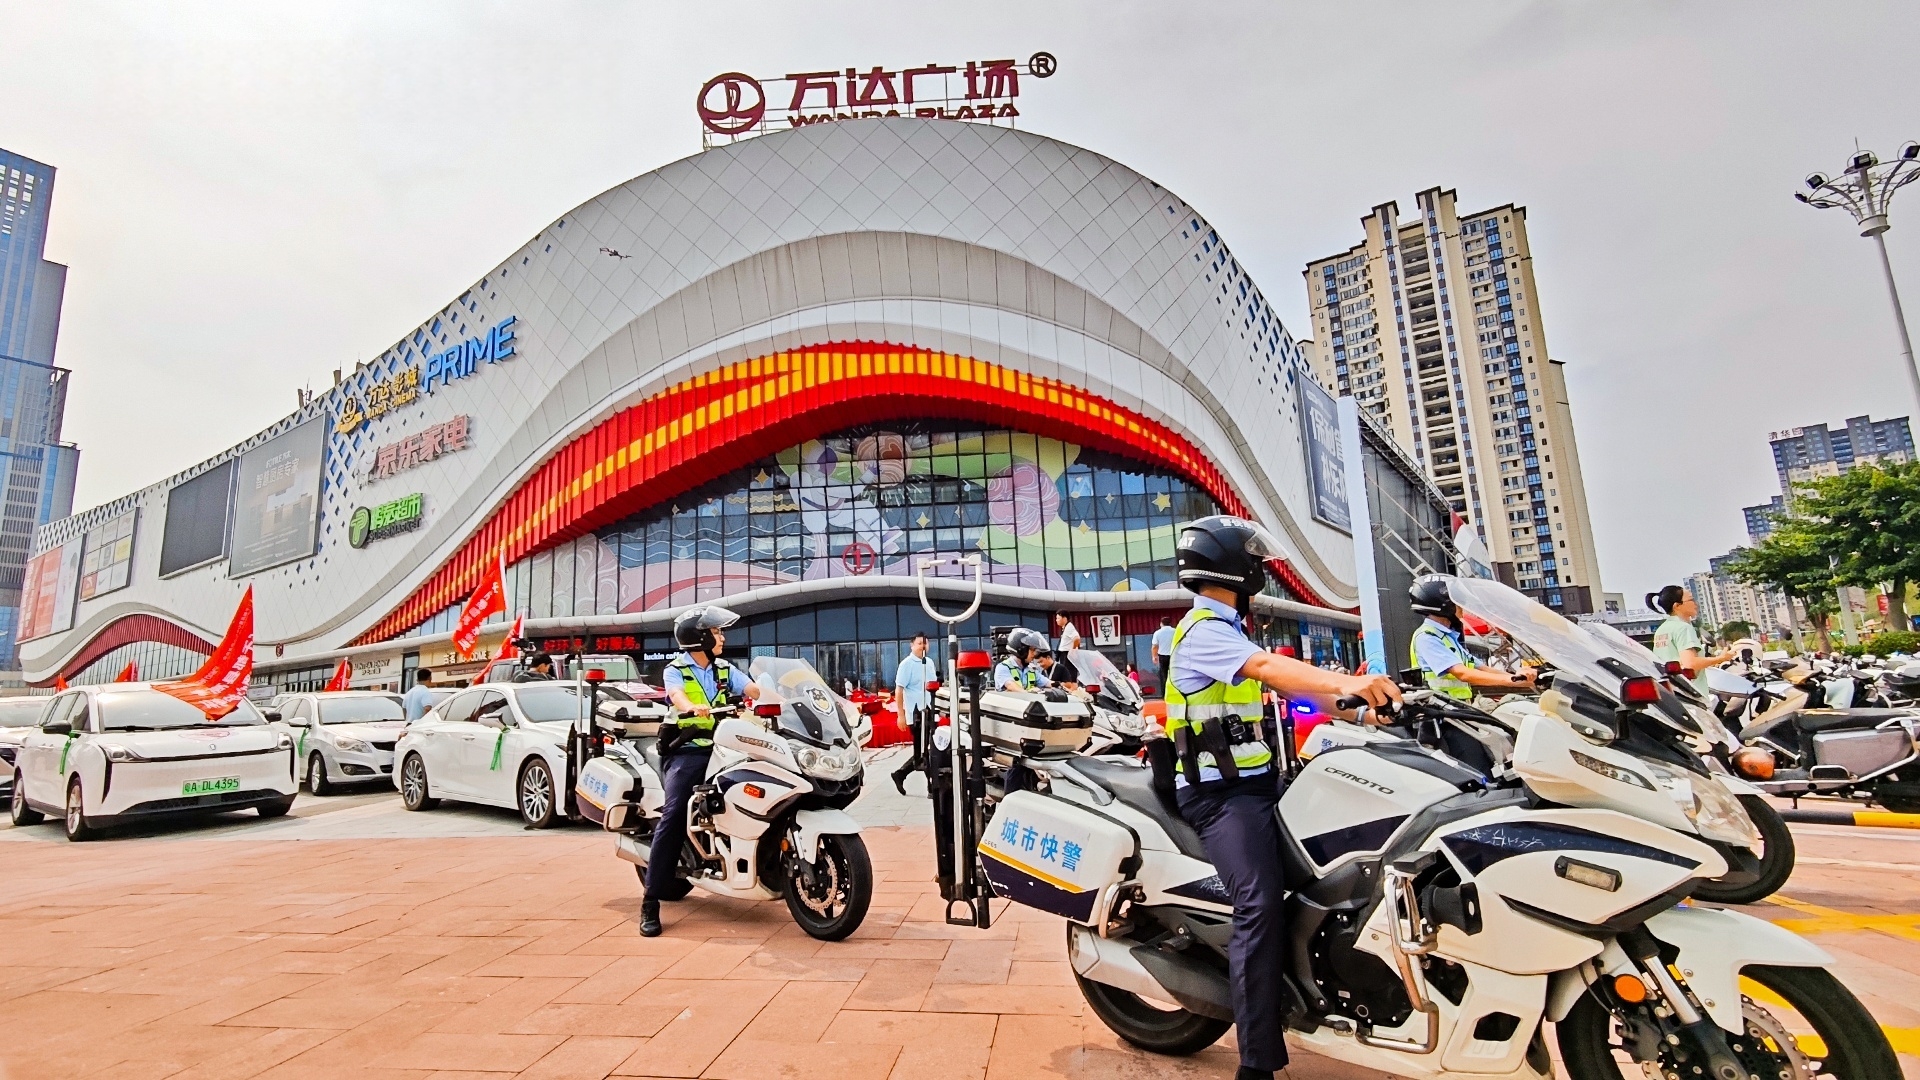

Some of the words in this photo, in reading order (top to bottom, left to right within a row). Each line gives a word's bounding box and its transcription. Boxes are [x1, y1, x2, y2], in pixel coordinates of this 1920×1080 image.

[785, 59, 1019, 110] 万达广场
[915, 103, 1020, 119] PLAZA
[423, 315, 517, 392] PRIME
[376, 414, 470, 478] 京东家电
[1768, 427, 1803, 440] 清华园
[644, 652, 665, 660] luckin
[202, 778, 239, 791] DL4395
[1324, 766, 1395, 795] CFMOTO
[1001, 816, 1083, 872] 城市快警
